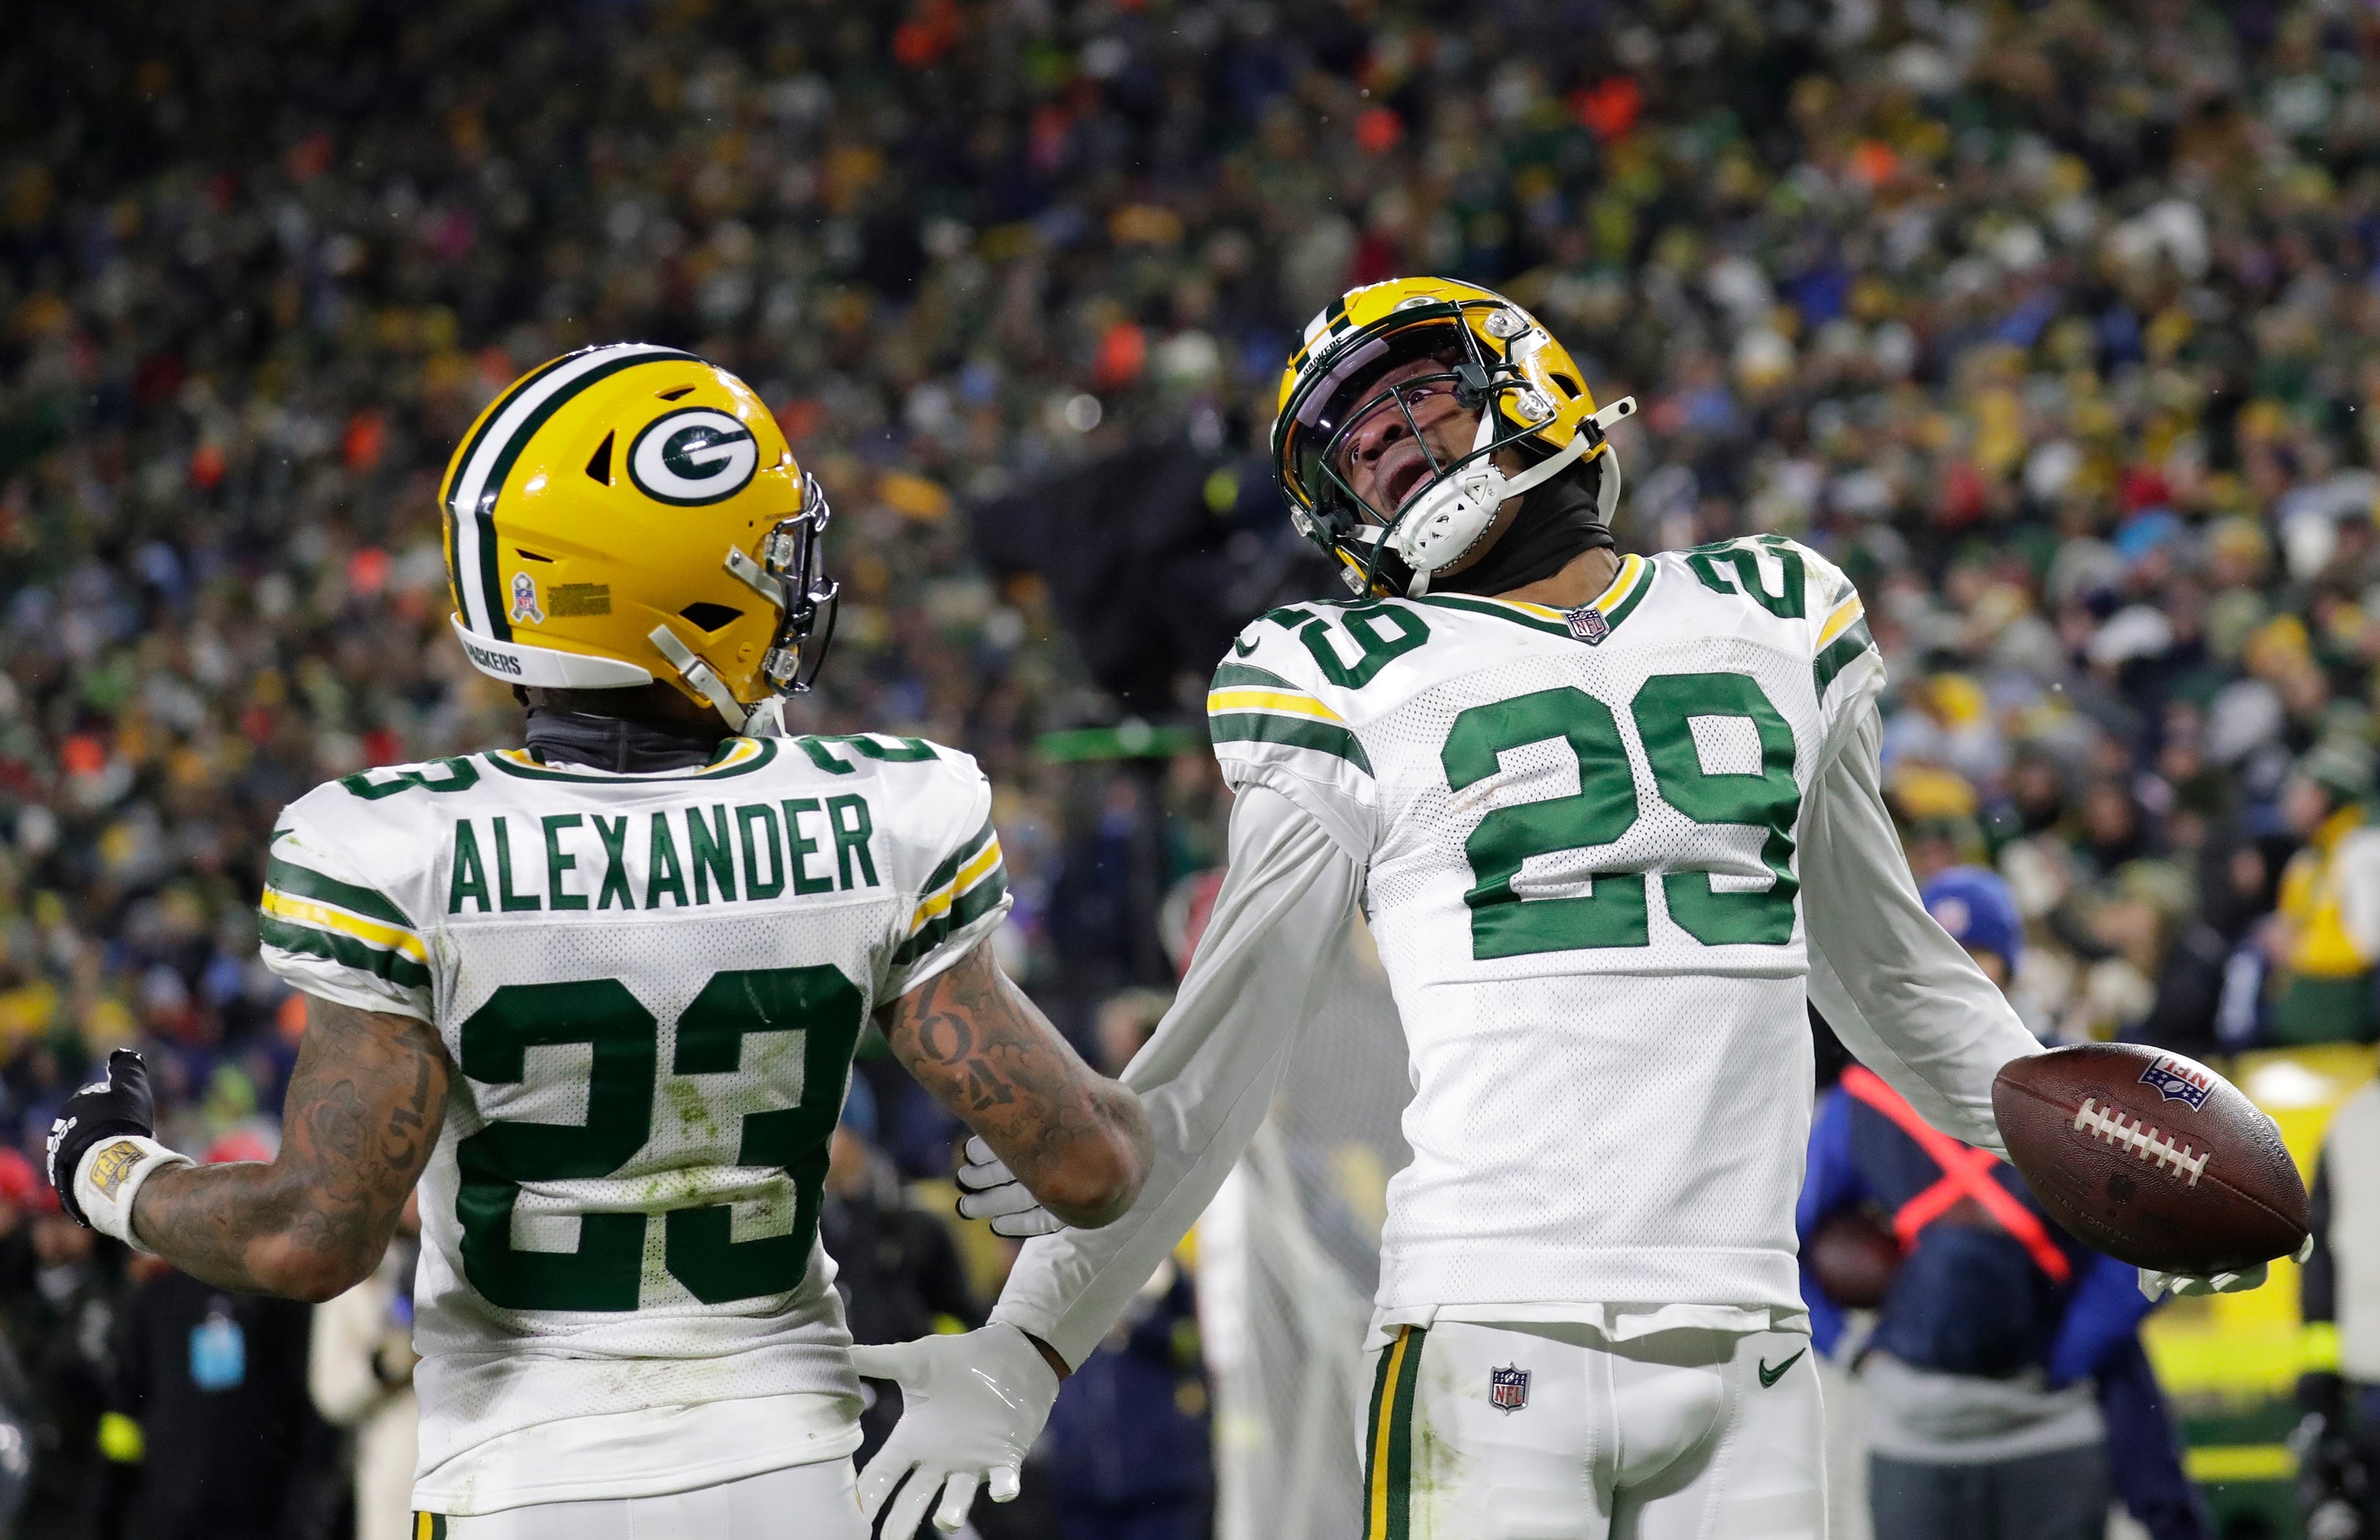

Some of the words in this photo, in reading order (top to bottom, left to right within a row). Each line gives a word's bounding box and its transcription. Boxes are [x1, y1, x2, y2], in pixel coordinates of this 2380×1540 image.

[631, 409, 756, 502] G
[1574, 618, 1604, 635] NFL
[1440, 672, 1801, 961] 29
[447, 793, 880, 915] ALEXANDER
[2163, 1057, 2210, 1090] NFL
[93, 1145, 131, 1181] NFL
[455, 963, 864, 1312] 23
[1494, 1385, 1523, 1405] NFL
